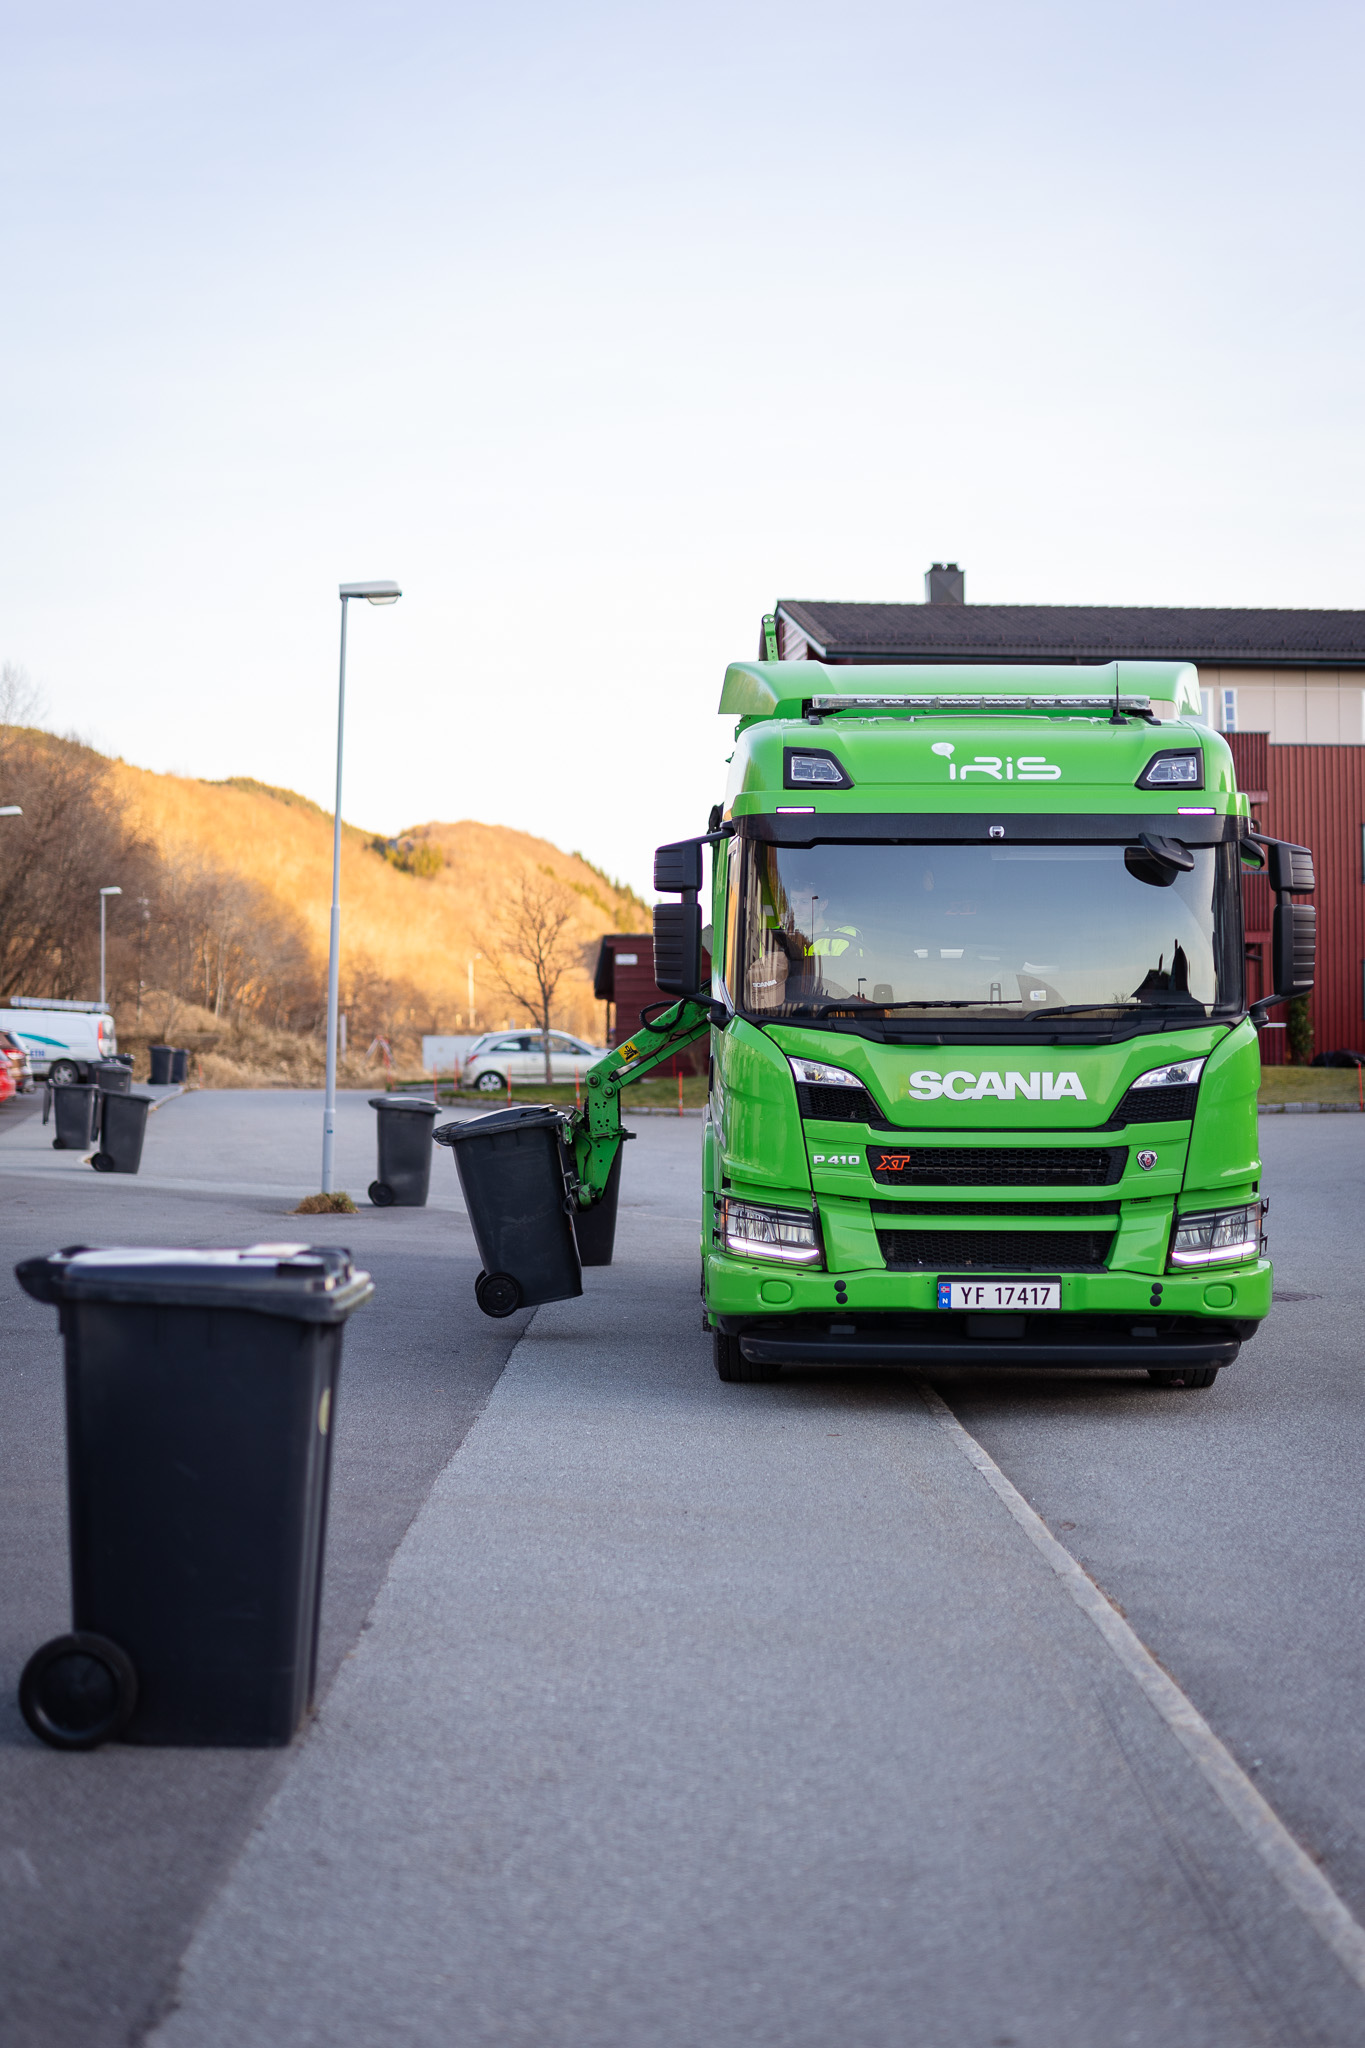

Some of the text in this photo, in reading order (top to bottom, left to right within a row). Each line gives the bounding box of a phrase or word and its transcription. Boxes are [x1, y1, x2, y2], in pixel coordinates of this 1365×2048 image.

[908, 1070, 1088, 1101] SCANIA
[813, 1155, 860, 1165] P 410
[876, 1155, 910, 1171] XT
[961, 1287, 1051, 1305] YF 17417
